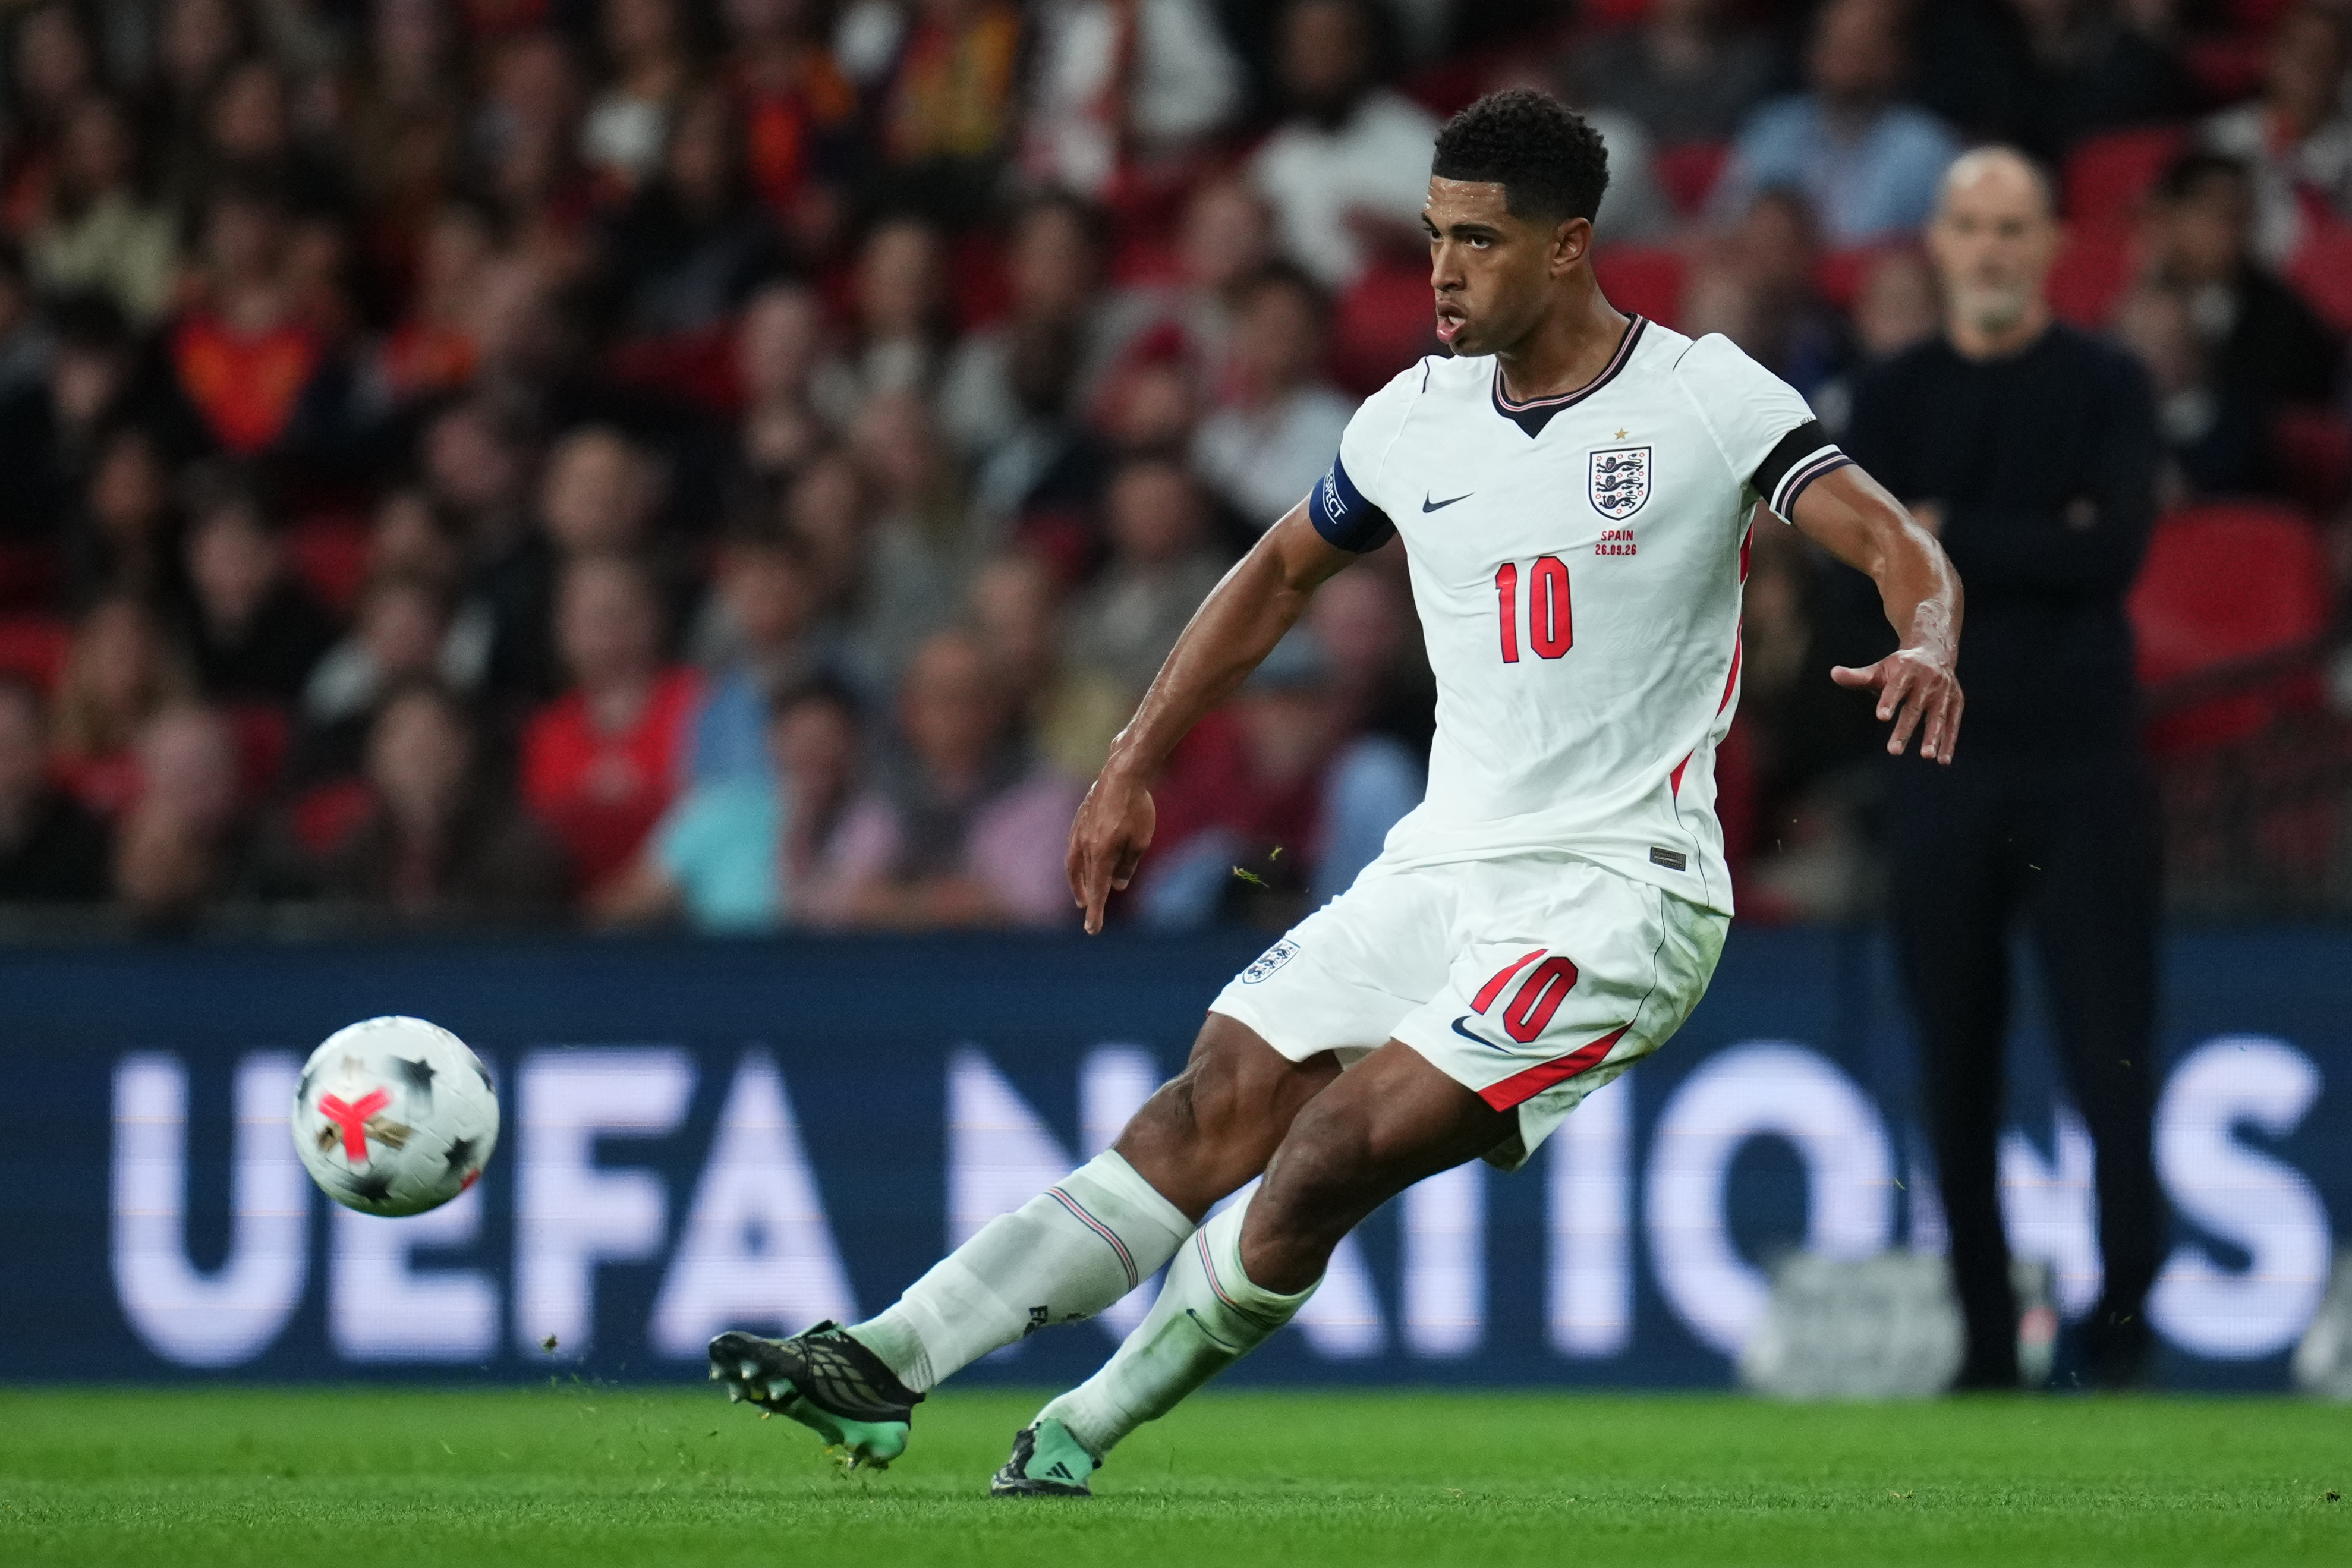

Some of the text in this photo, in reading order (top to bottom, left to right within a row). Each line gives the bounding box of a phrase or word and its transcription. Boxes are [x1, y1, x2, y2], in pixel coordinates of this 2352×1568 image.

[1595, 544, 1637, 556] 26.09.26
[1601, 530, 1633, 541] SPAIN
[1495, 556, 1573, 663] 10
[1469, 948, 1579, 1044] 10
[944, 1035, 2333, 1362] NIOS
